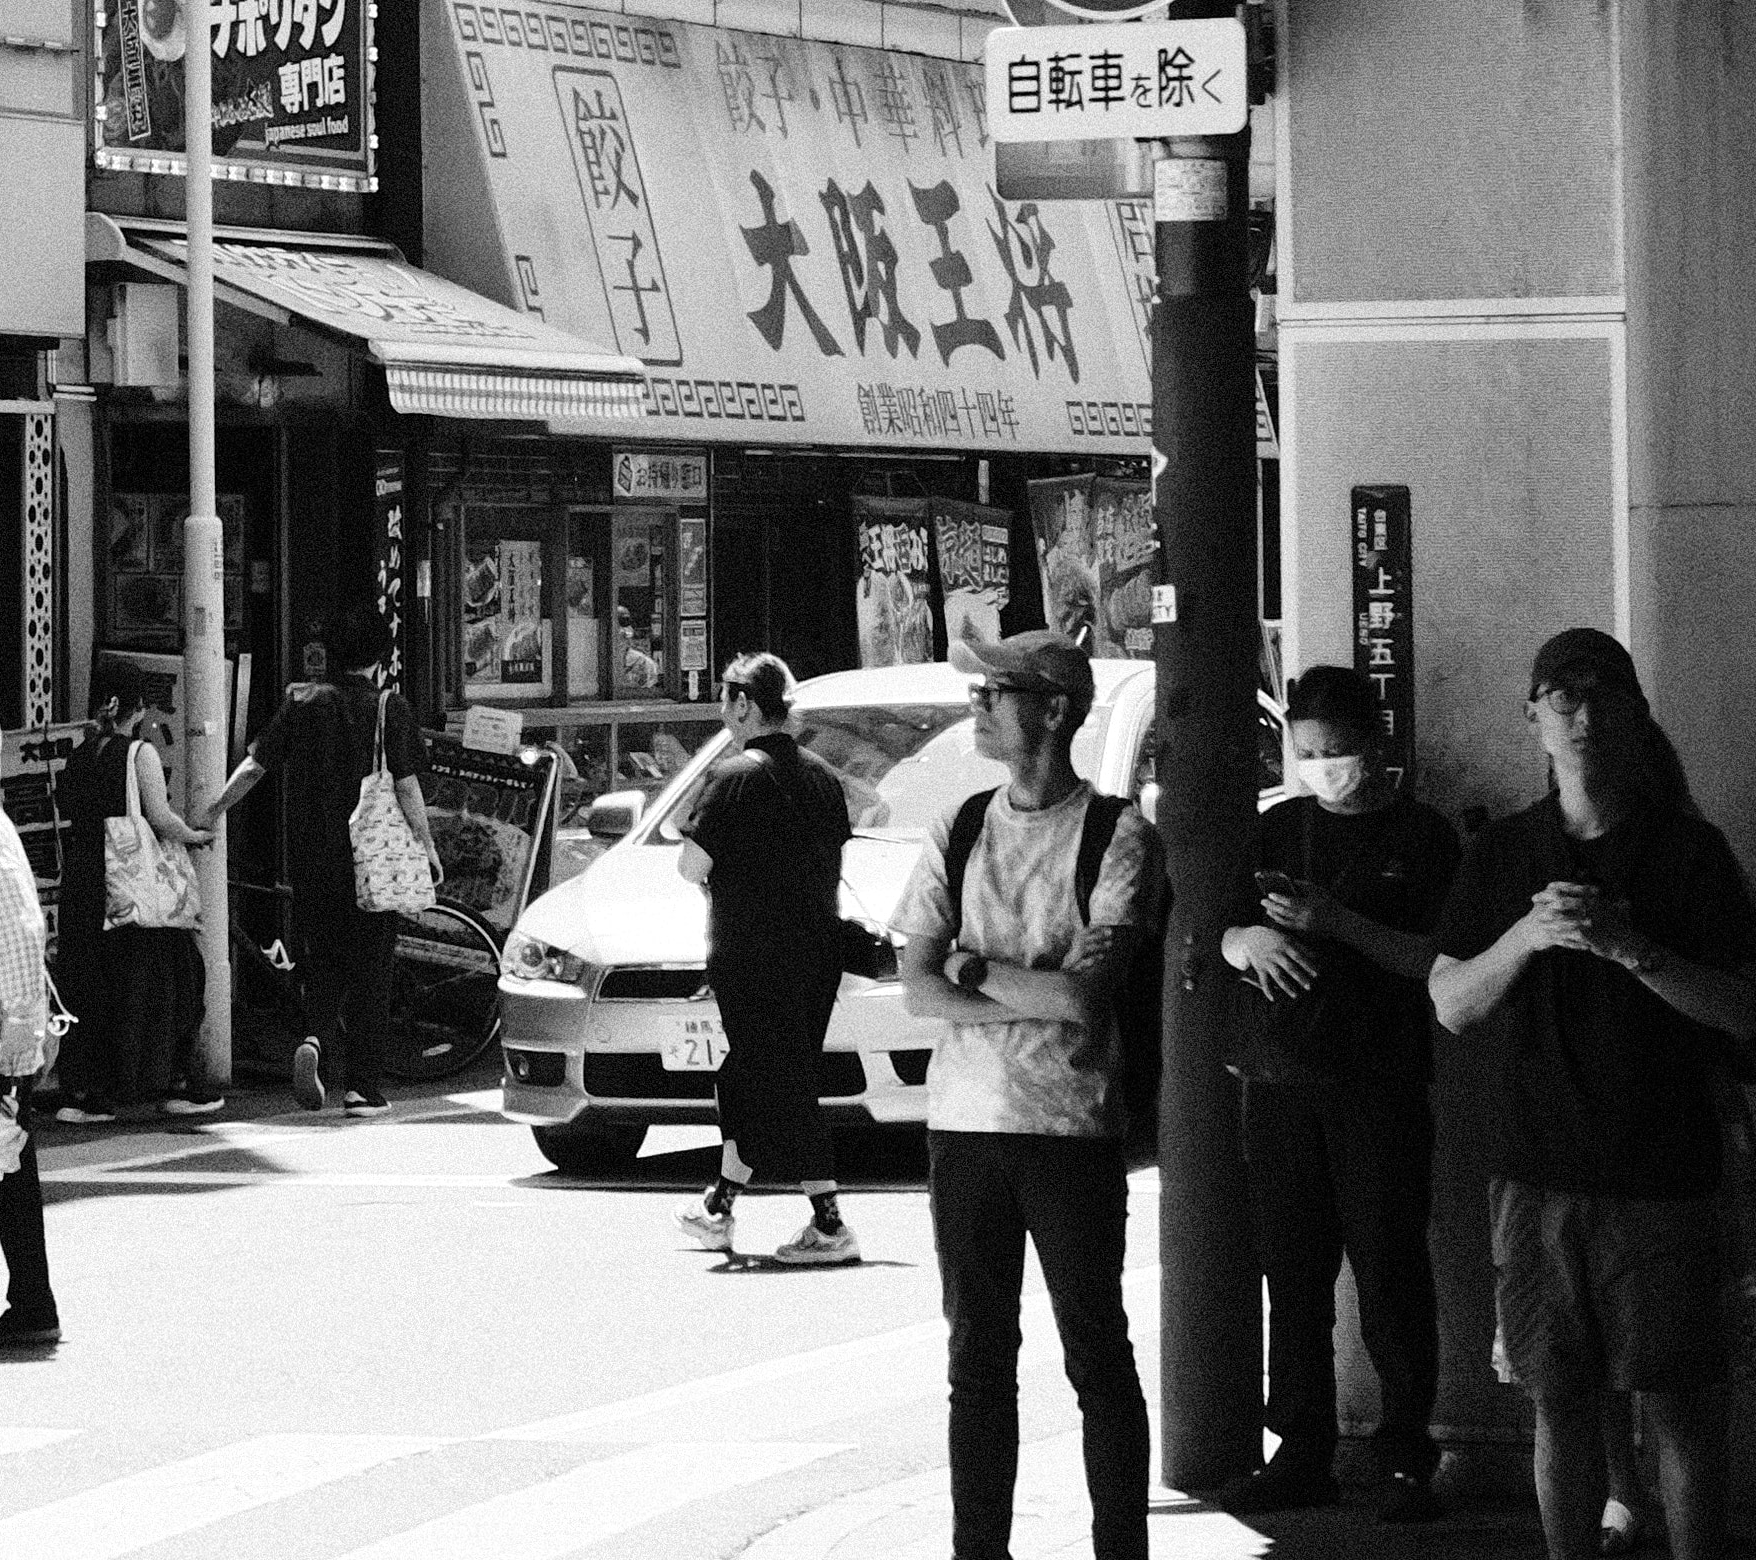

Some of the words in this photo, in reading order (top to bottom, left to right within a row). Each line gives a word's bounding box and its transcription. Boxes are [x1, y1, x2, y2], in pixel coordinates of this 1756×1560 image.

[277, 54, 347, 115] 専門店
[1008, 46, 1223, 115] 自転車を除く
[572, 84, 662, 346] 餃子
[739, 168, 1080, 385] 大阪王将
[857, 381, 1020, 441] 創業昭和四十四年
